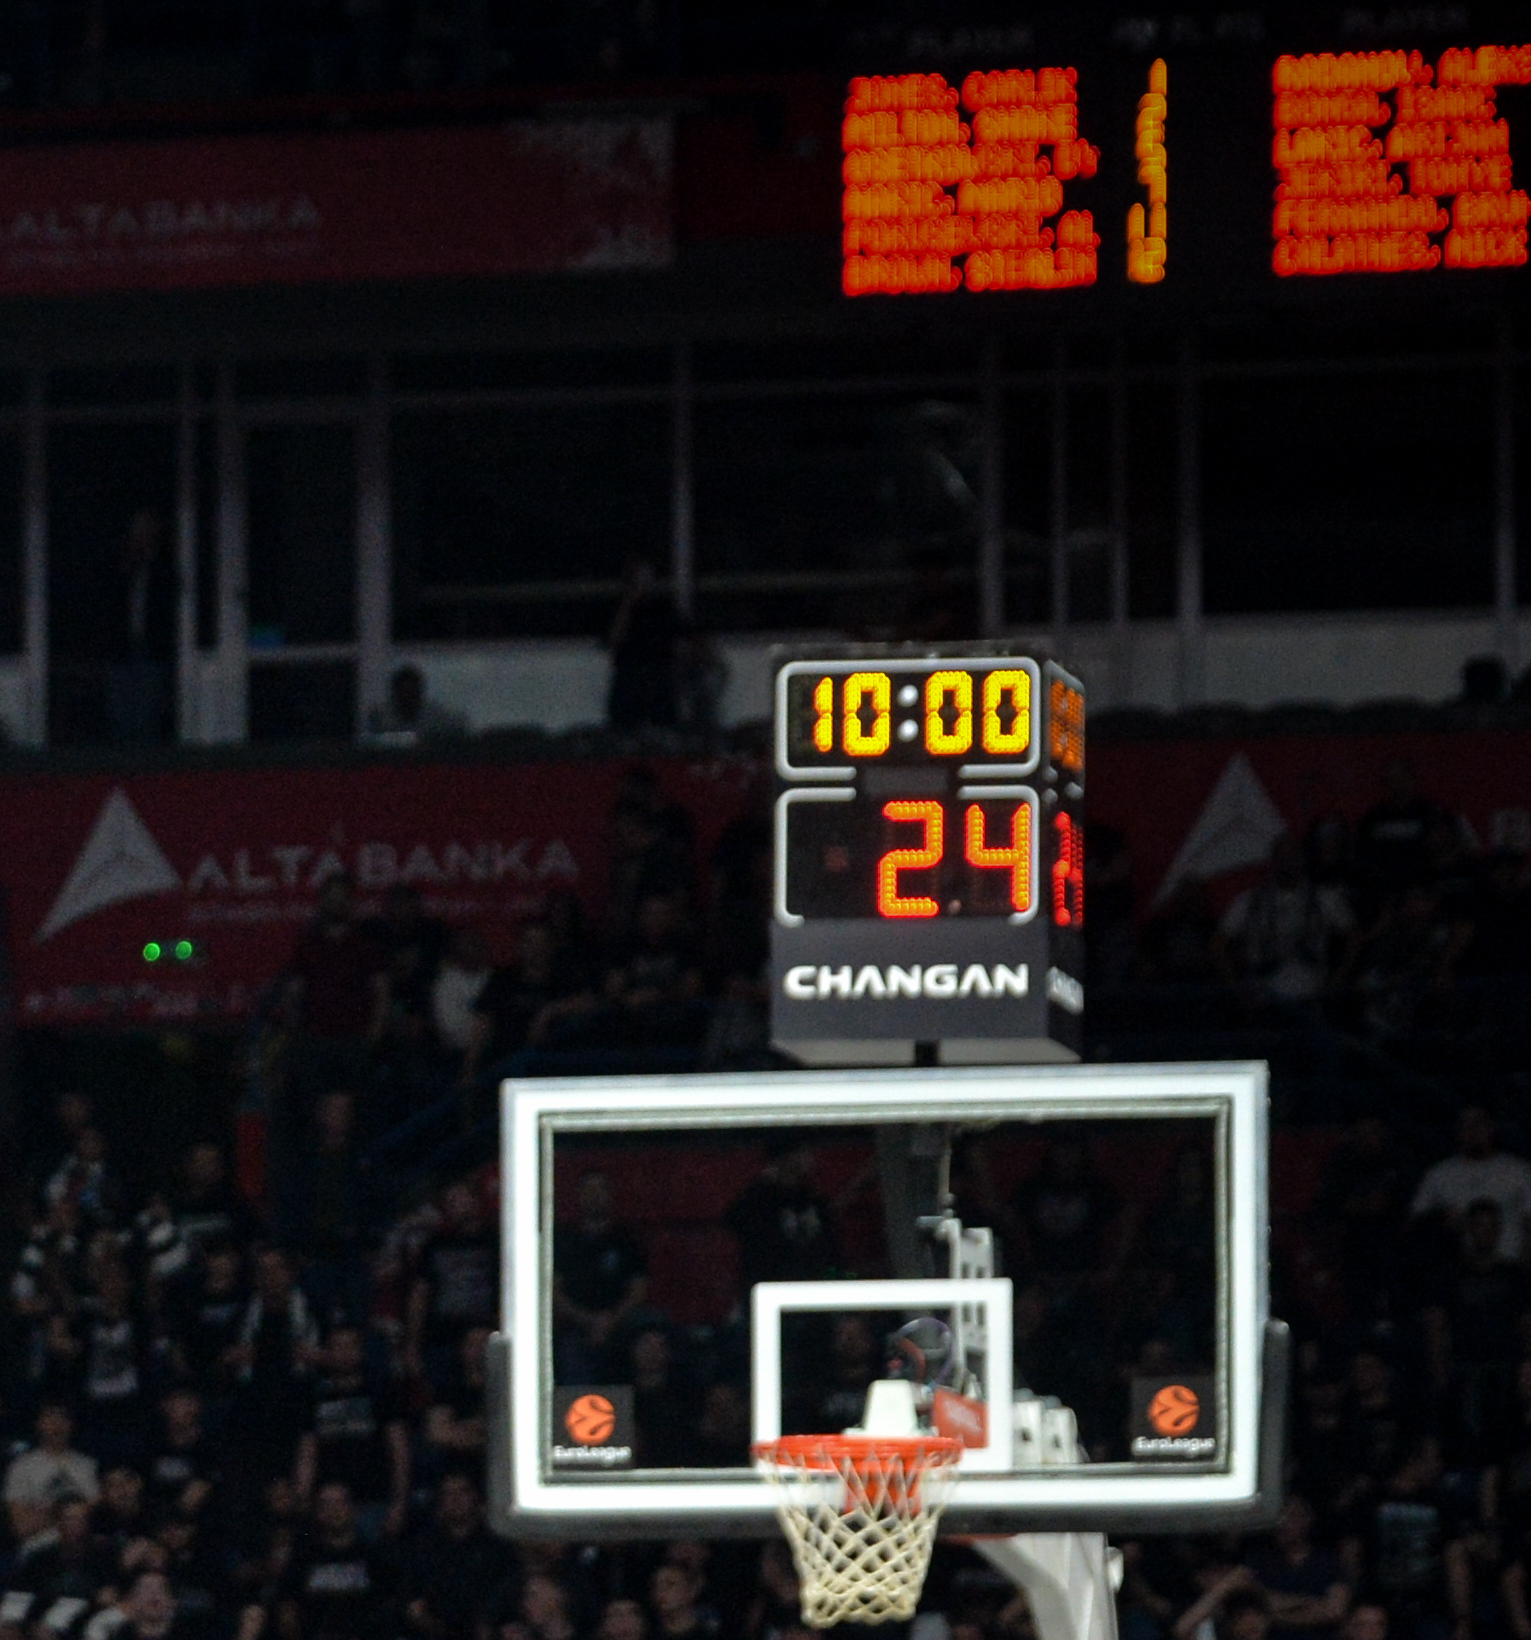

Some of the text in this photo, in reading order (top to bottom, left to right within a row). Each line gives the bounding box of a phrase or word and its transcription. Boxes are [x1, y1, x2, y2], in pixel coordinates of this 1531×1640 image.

[813, 669, 1030, 757] 10:00
[878, 801, 1031, 918] 24
[783, 963, 1030, 1000] CHANGAN
